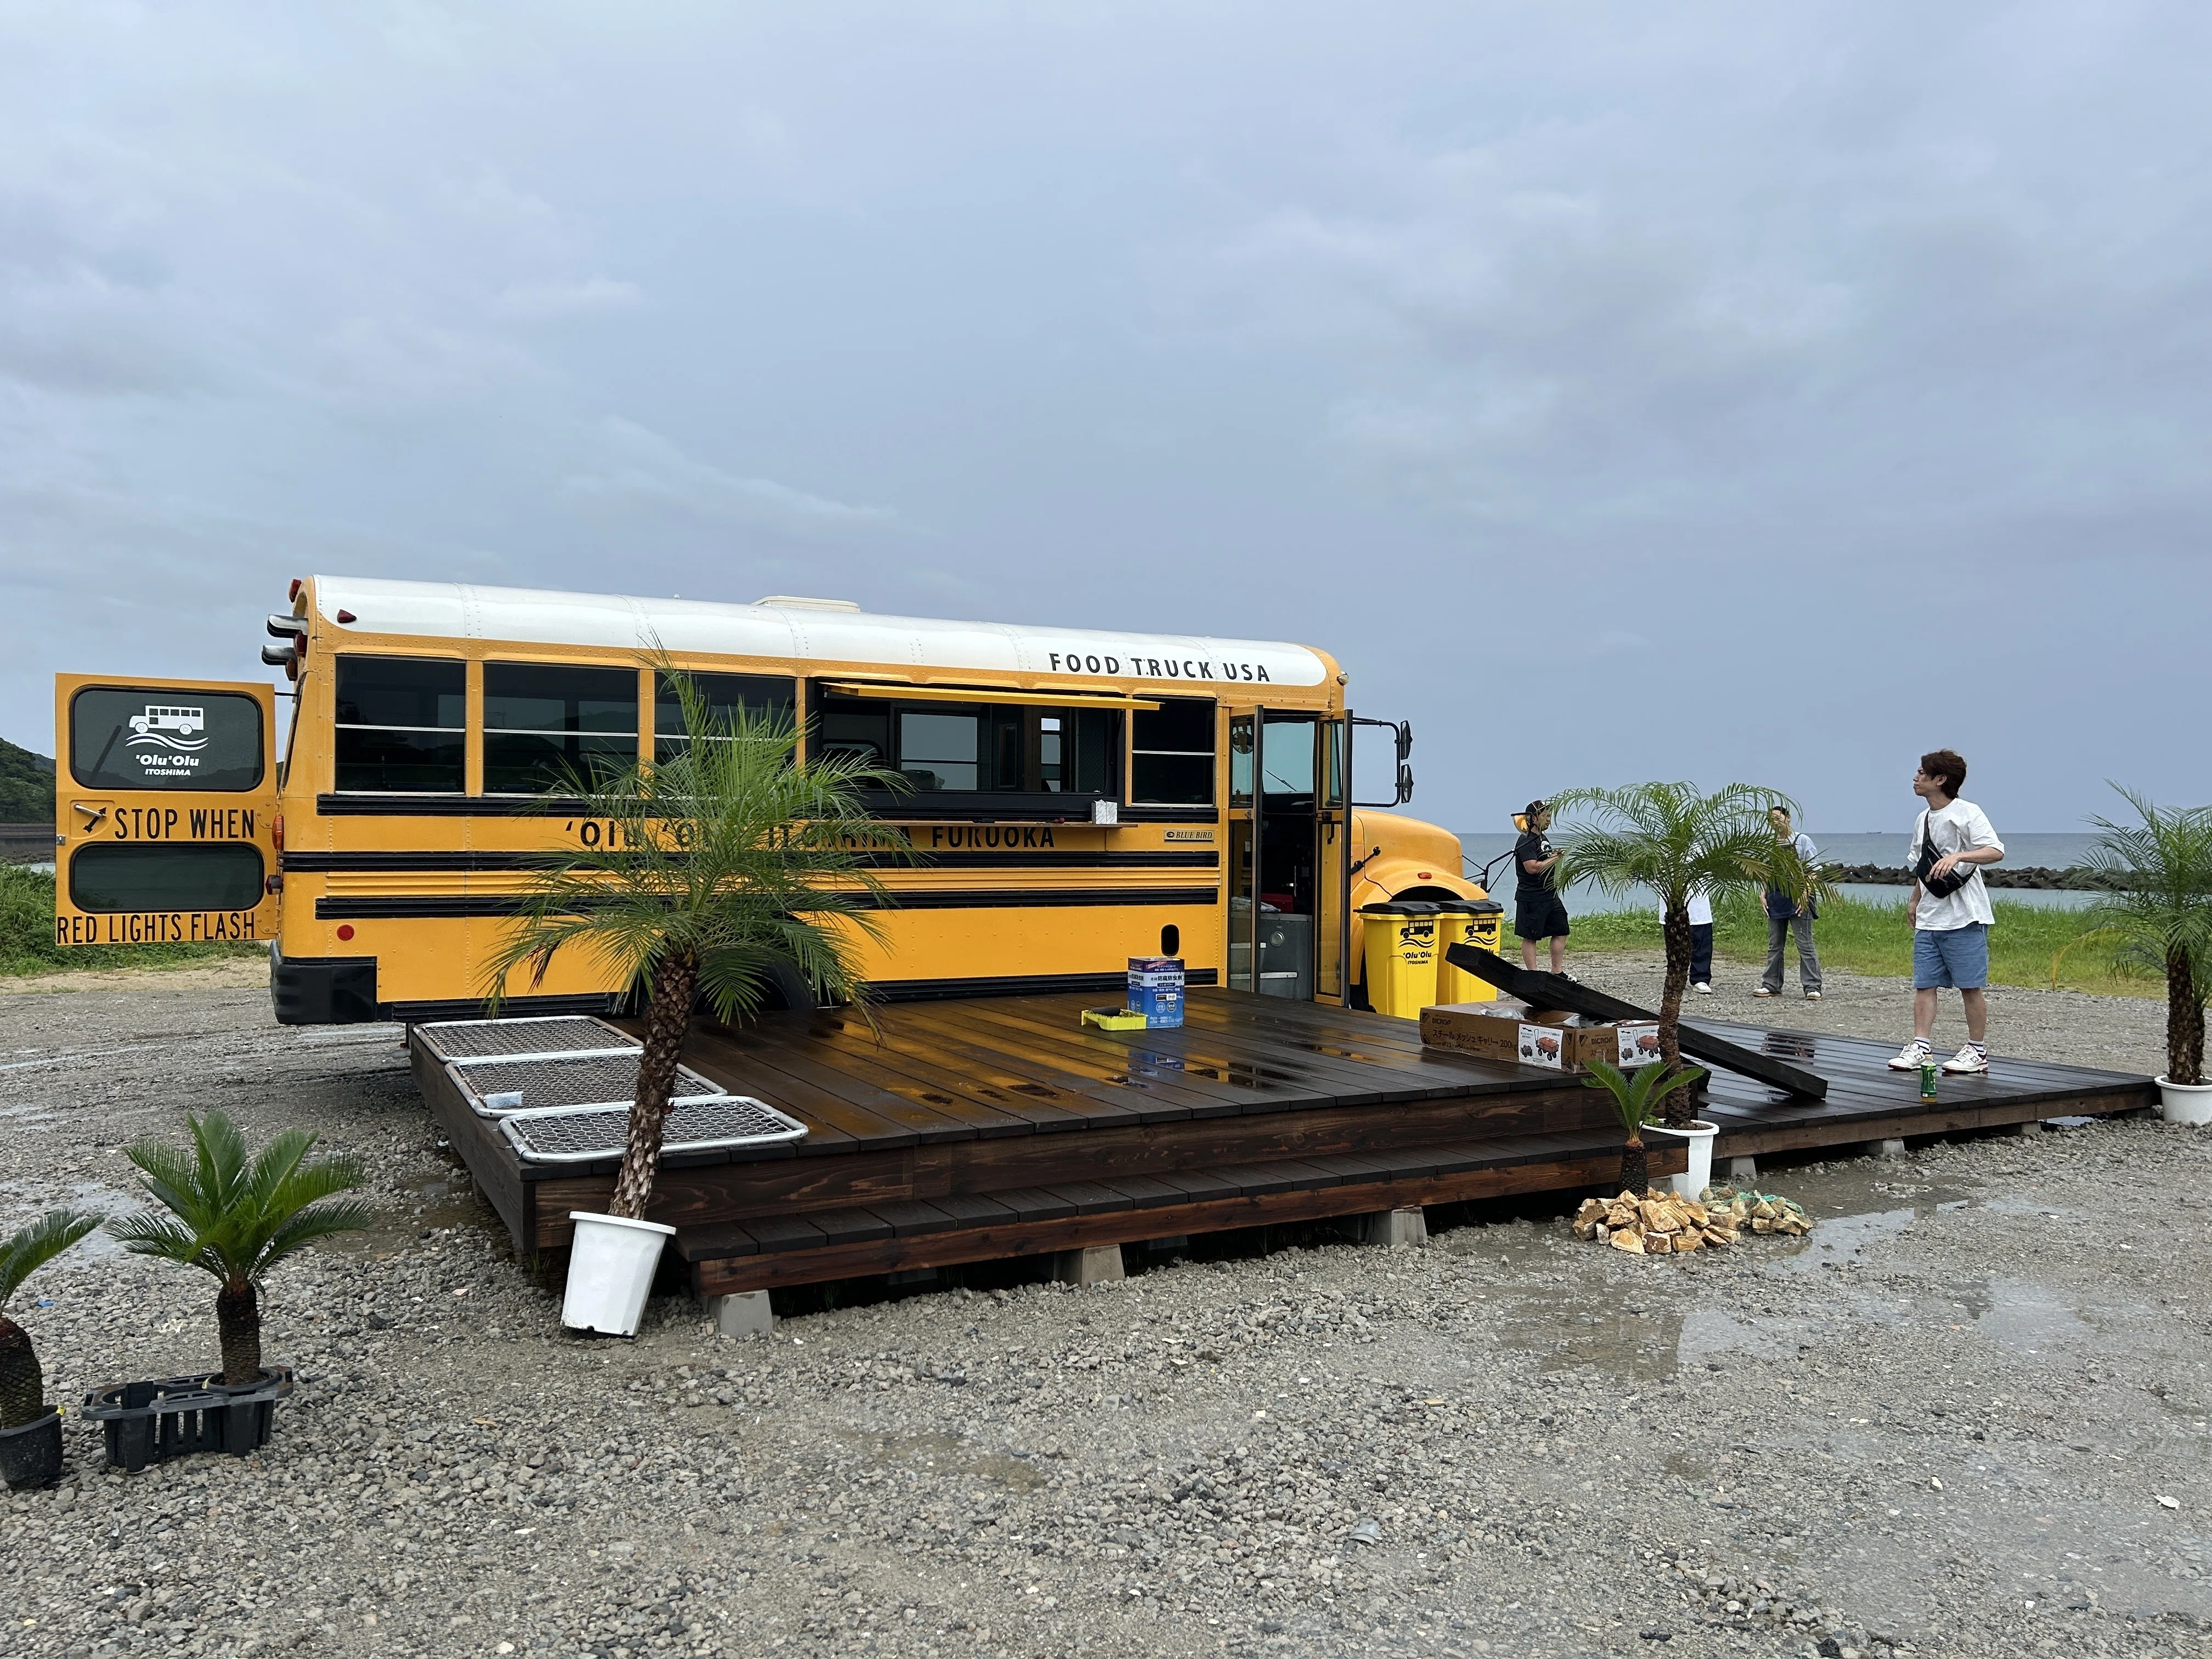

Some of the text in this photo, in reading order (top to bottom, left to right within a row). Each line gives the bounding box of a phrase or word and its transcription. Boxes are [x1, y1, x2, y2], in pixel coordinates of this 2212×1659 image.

[1049, 653, 1270, 682] FOOD TRUCK USA
[115, 808, 255, 839] STOP WHEN
[933, 826, 1054, 848] FUKUOKA
[57, 912, 255, 944] RED LIGHTS FLASH
